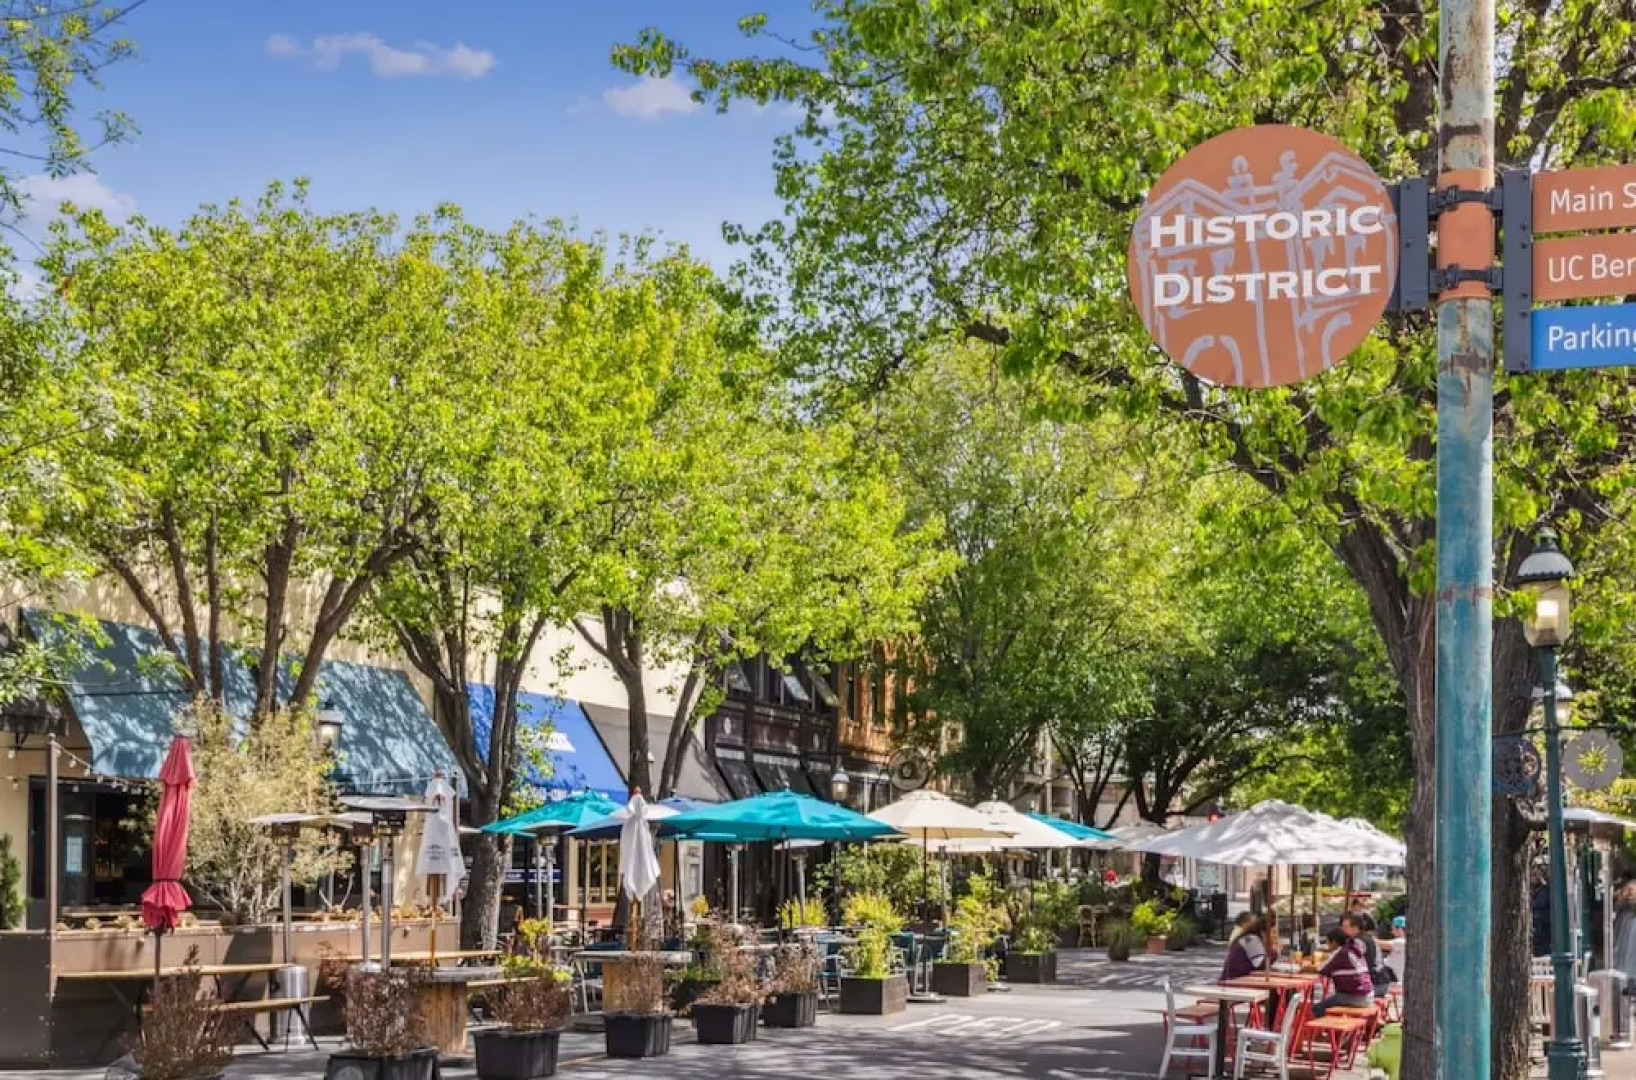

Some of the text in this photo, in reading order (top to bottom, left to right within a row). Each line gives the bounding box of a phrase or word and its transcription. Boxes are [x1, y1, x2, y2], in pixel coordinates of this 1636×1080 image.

[1550, 185, 1614, 215] Main
[1149, 205, 1387, 249] HISTORIC
[1548, 254, 1583, 283] UC
[1153, 264, 1381, 307] DISTRICT
[1548, 321, 1636, 352] Parkin
